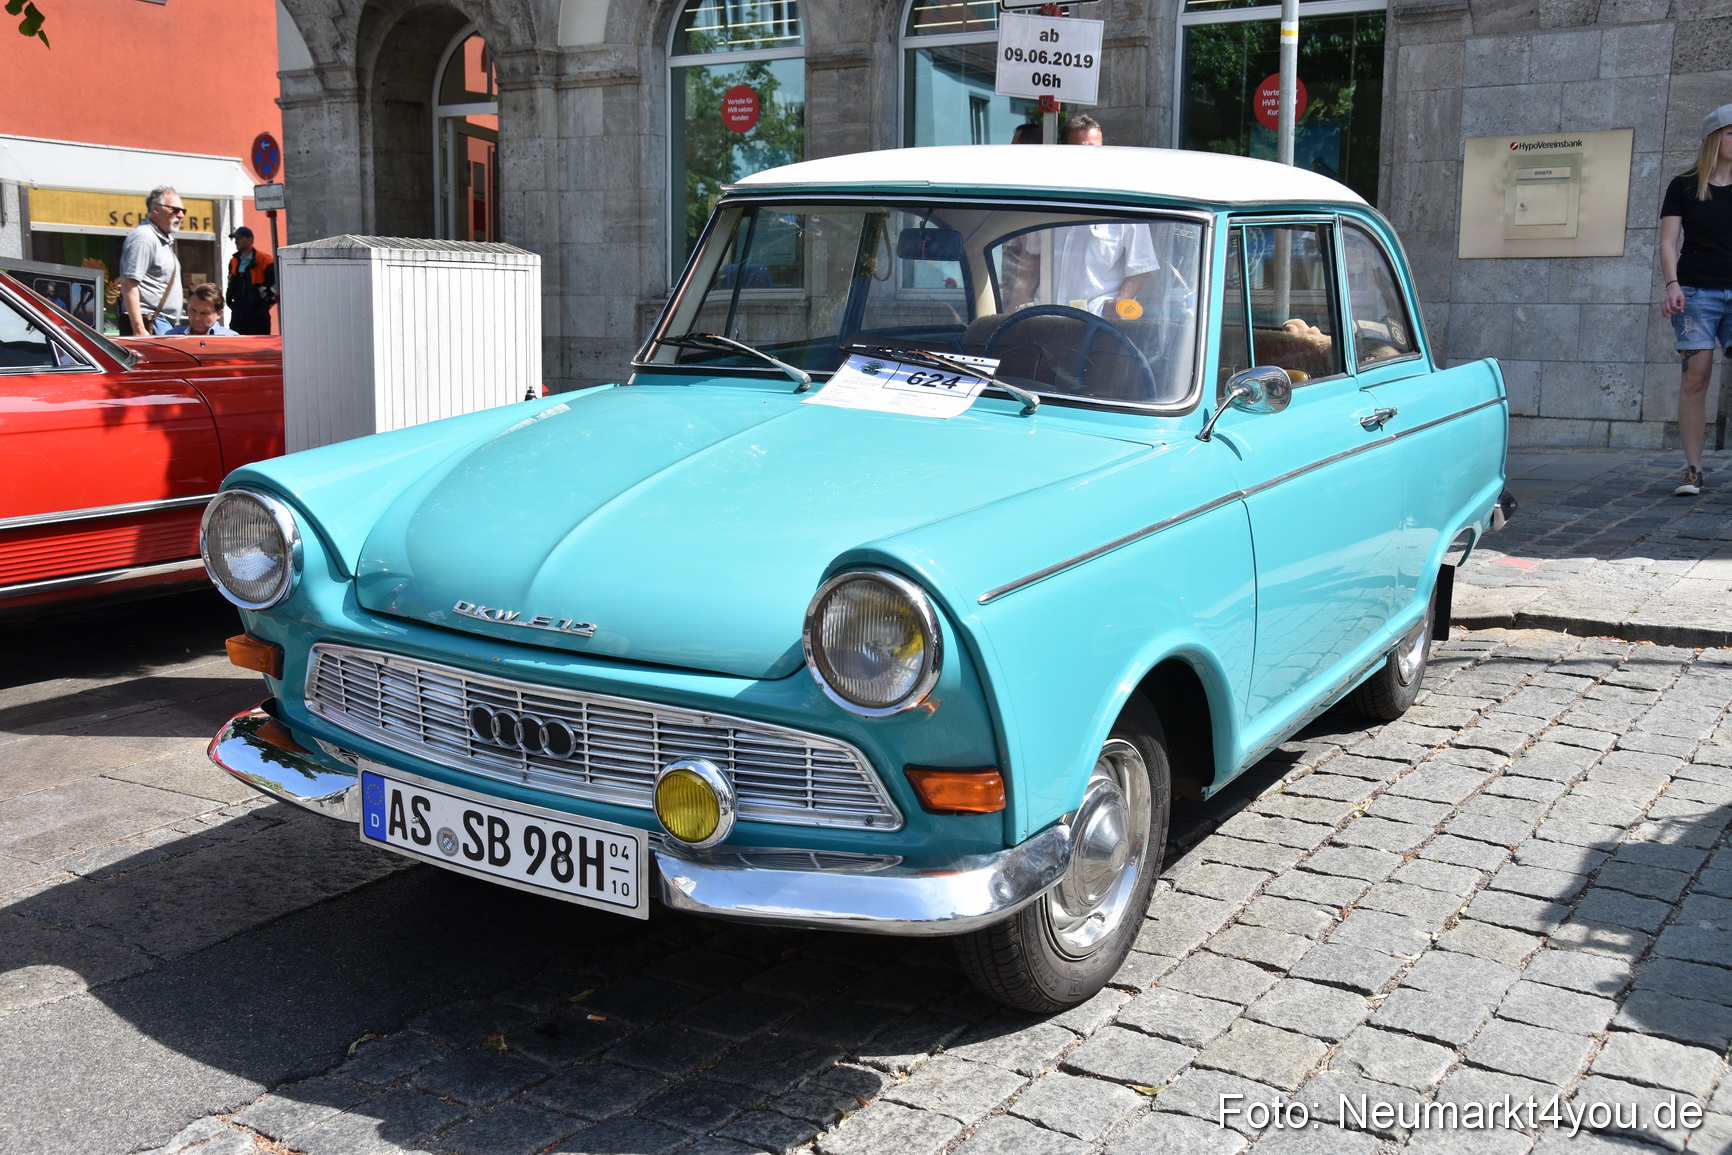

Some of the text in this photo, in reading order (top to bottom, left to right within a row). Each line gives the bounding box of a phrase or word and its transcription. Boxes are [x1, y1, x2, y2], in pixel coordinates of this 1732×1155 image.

[1039, 28, 1060, 43] ab
[1004, 47, 1094, 69] 09.06.2019
[1031, 72, 1062, 89] 06h
[1262, 98, 1276, 106] HVB
[1519, 139, 1583, 151] HypoVereinsbank
[906, 371, 962, 390] 624
[453, 599, 521, 622] DKW
[371, 813, 380, 828] D
[388, 788, 432, 846] AS
[462, 809, 512, 868] SB
[523, 825, 605, 892] 98H
[609, 842, 630, 861] 04
[611, 879, 630, 897] 10
